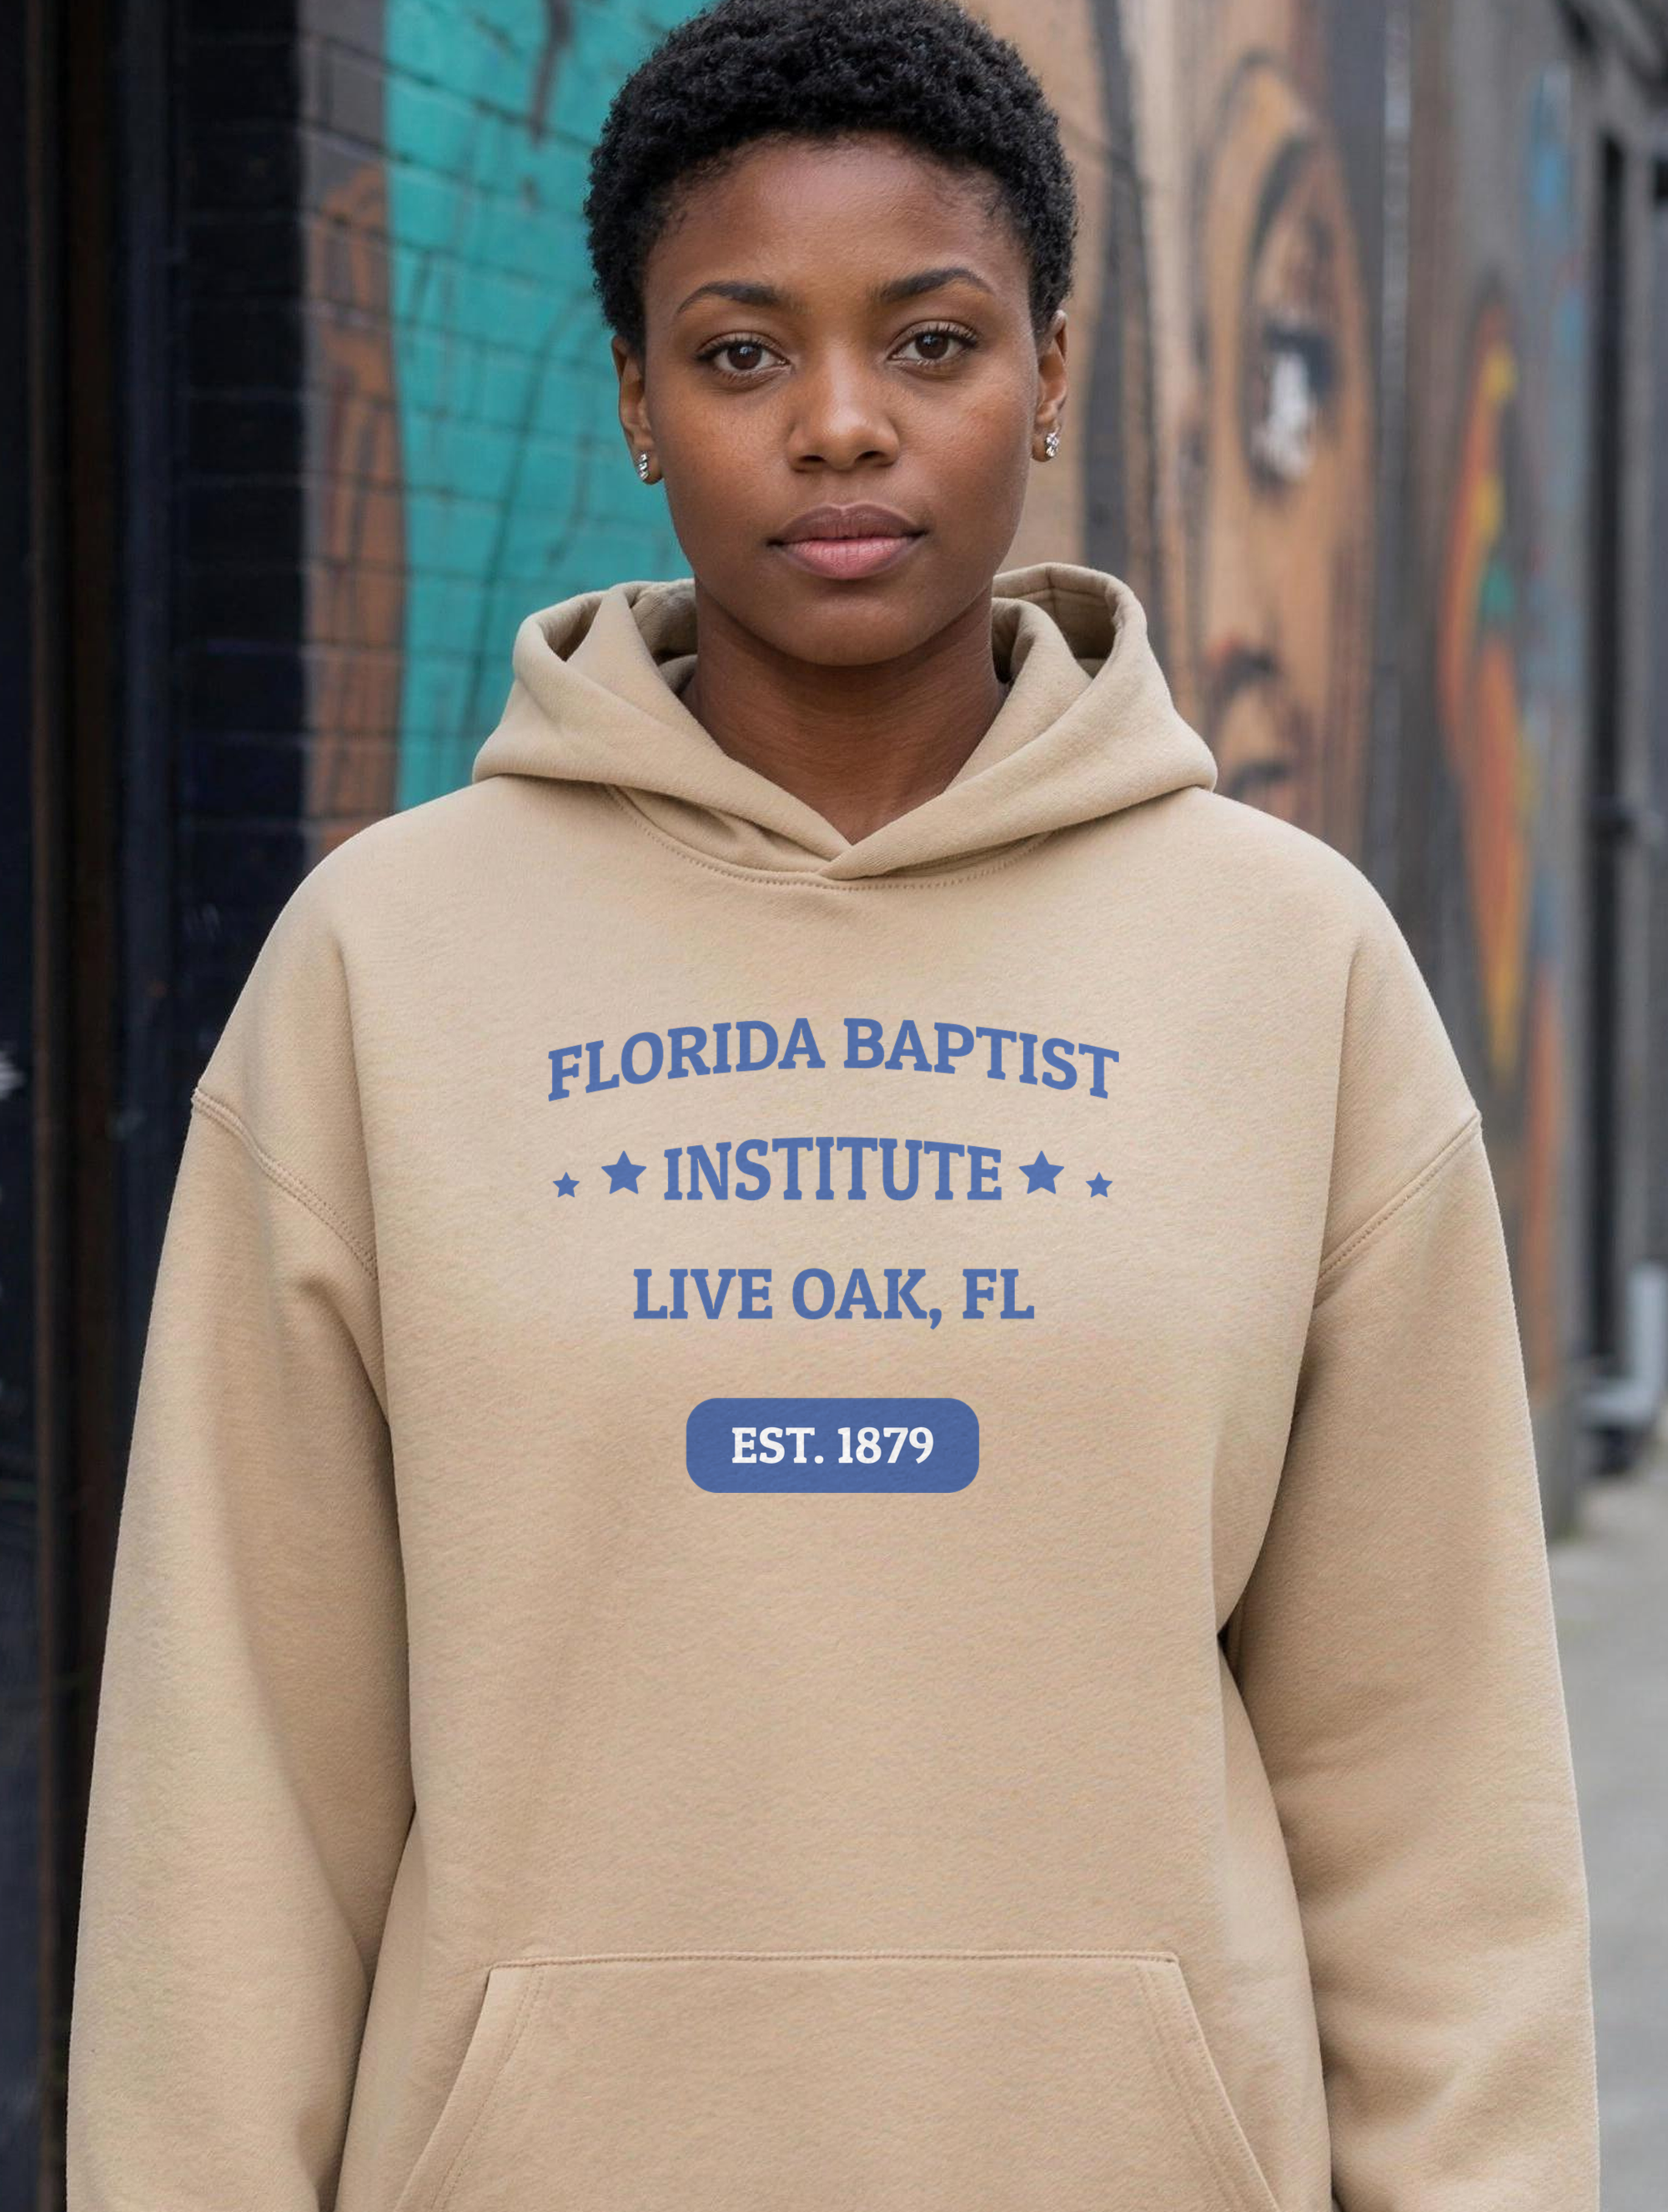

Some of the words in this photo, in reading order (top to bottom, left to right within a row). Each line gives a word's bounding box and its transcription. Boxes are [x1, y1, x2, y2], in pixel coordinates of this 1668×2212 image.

[547, 1017, 826, 1102] FLORIDA
[843, 1018, 1120, 1099] BAPTIST
[663, 1136, 1002, 1201] INSTITUTE
[633, 1268, 773, 1320] LIVE
[791, 1268, 942, 1330] OAK,
[962, 1268, 1035, 1320] FL
[731, 1426, 824, 1464] EST.
[837, 1426, 934, 1464] 1879
